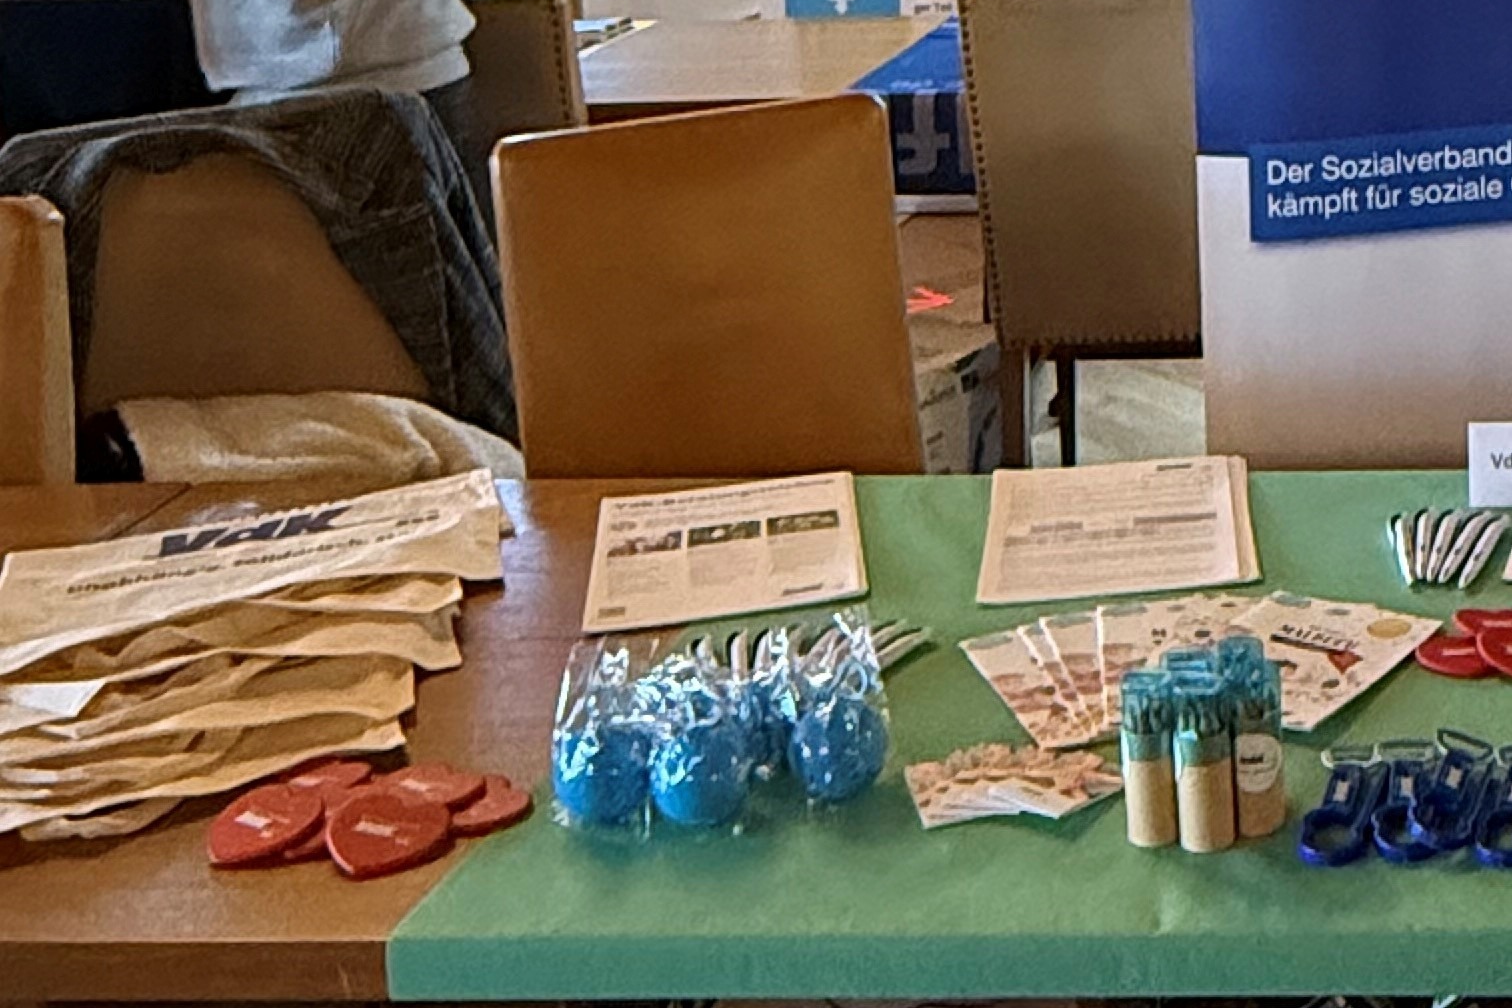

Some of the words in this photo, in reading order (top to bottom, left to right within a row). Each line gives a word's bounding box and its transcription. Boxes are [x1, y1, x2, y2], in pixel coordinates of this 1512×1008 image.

[1267, 159, 1313, 186] Der
[1321, 139, 1512, 182] Sozialverband
[1267, 188, 1358, 220] kämpft
[1367, 182, 1400, 210] für
[1410, 175, 1503, 205] soziale
[159, 506, 352, 558] VdK
